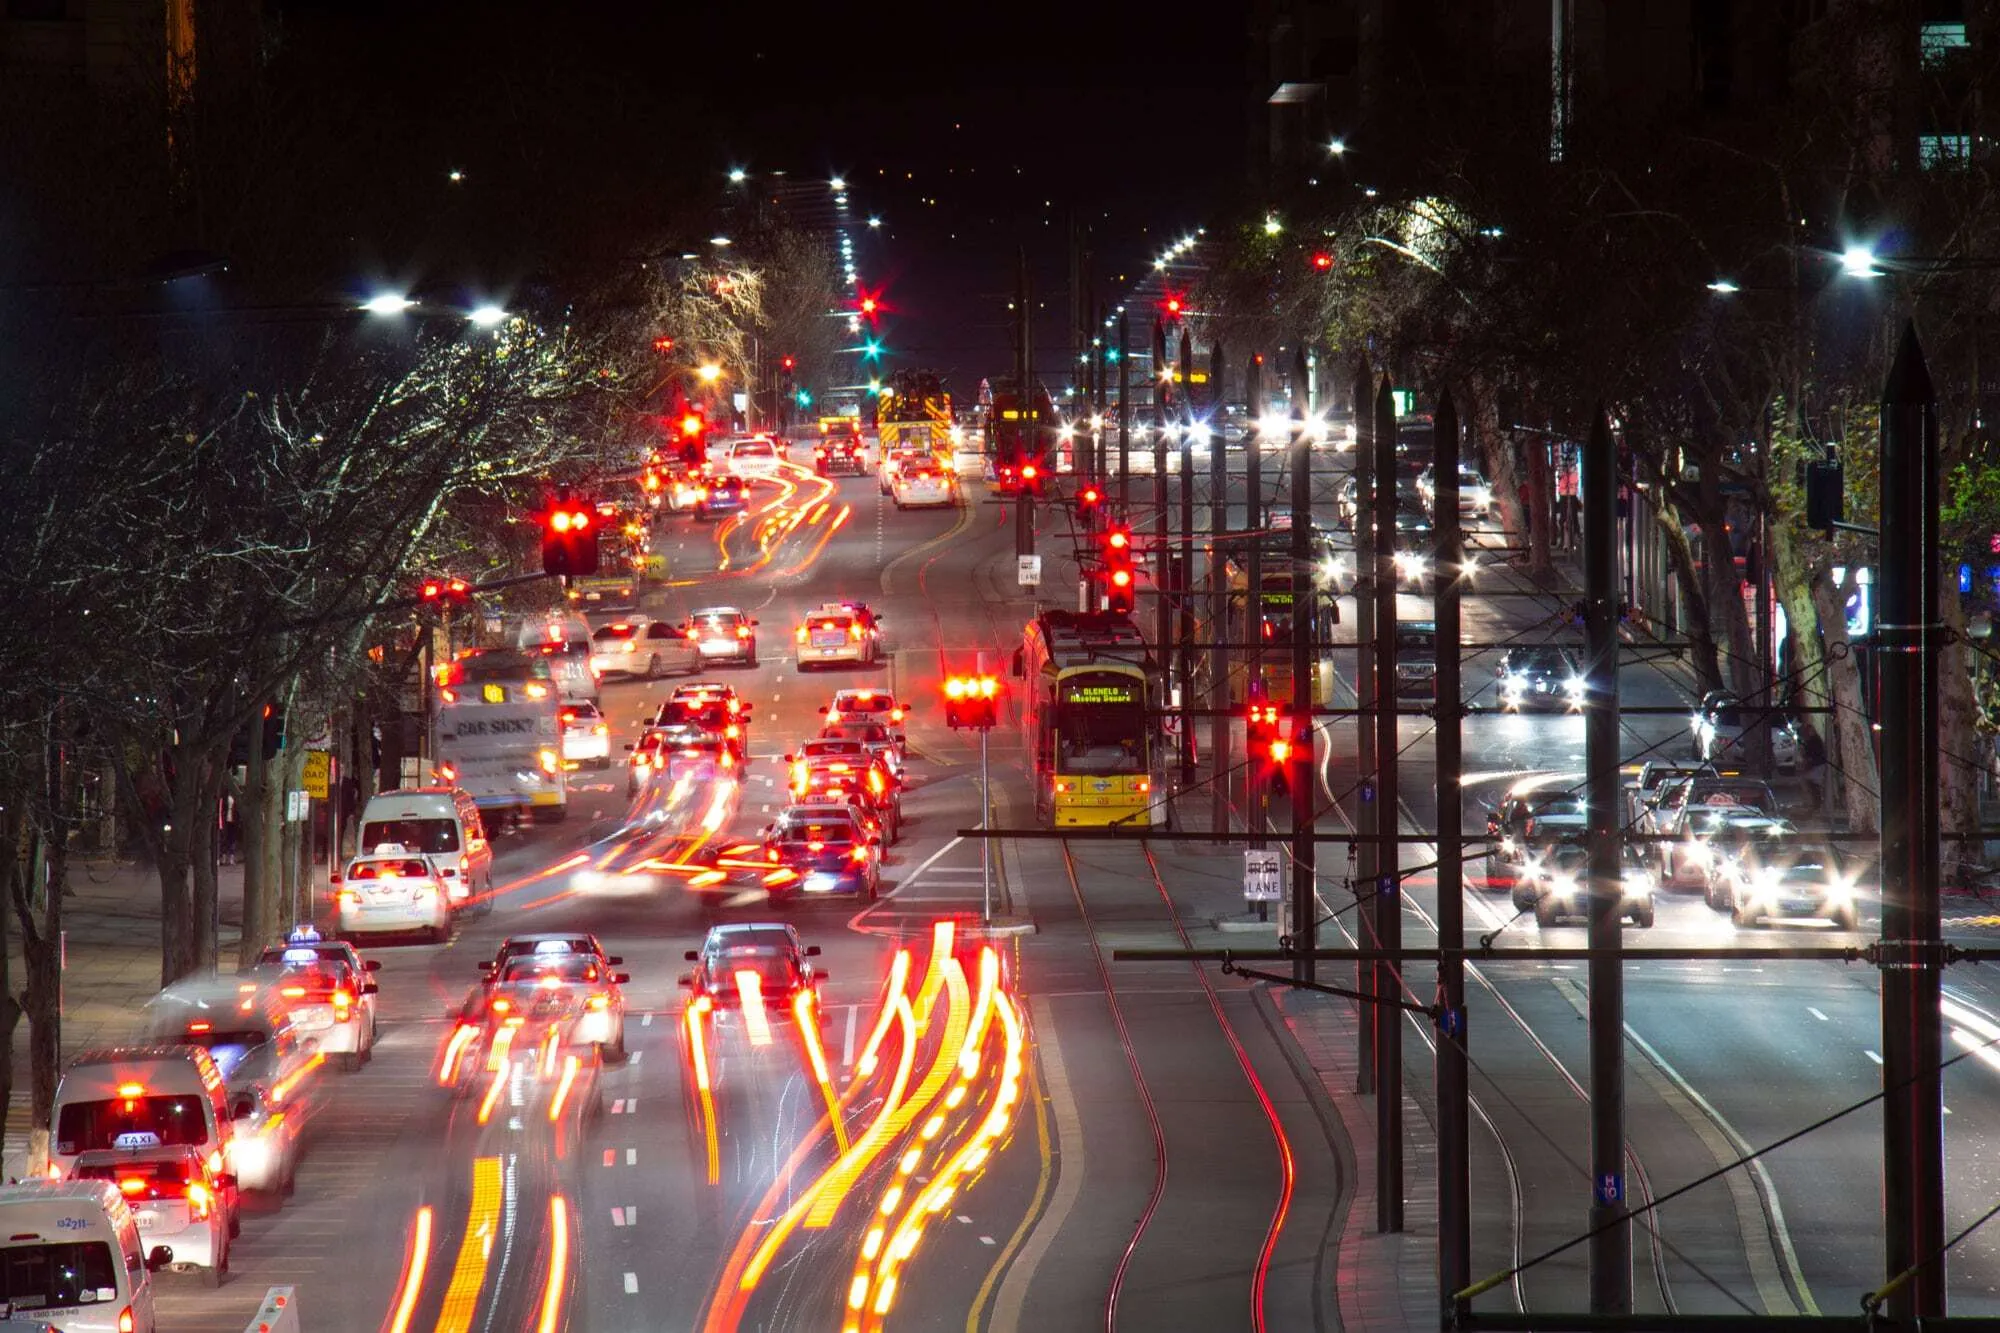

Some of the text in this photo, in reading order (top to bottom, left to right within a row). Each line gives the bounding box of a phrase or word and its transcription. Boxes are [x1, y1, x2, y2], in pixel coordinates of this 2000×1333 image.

[457, 722, 487, 736] CAR
[304, 770, 325, 779] OAD
[305, 784, 325, 793] ORK
[1248, 882, 1278, 893] LANE
[124, 1136, 151, 1145] TAXI
[1605, 1175, 1615, 1186] H
